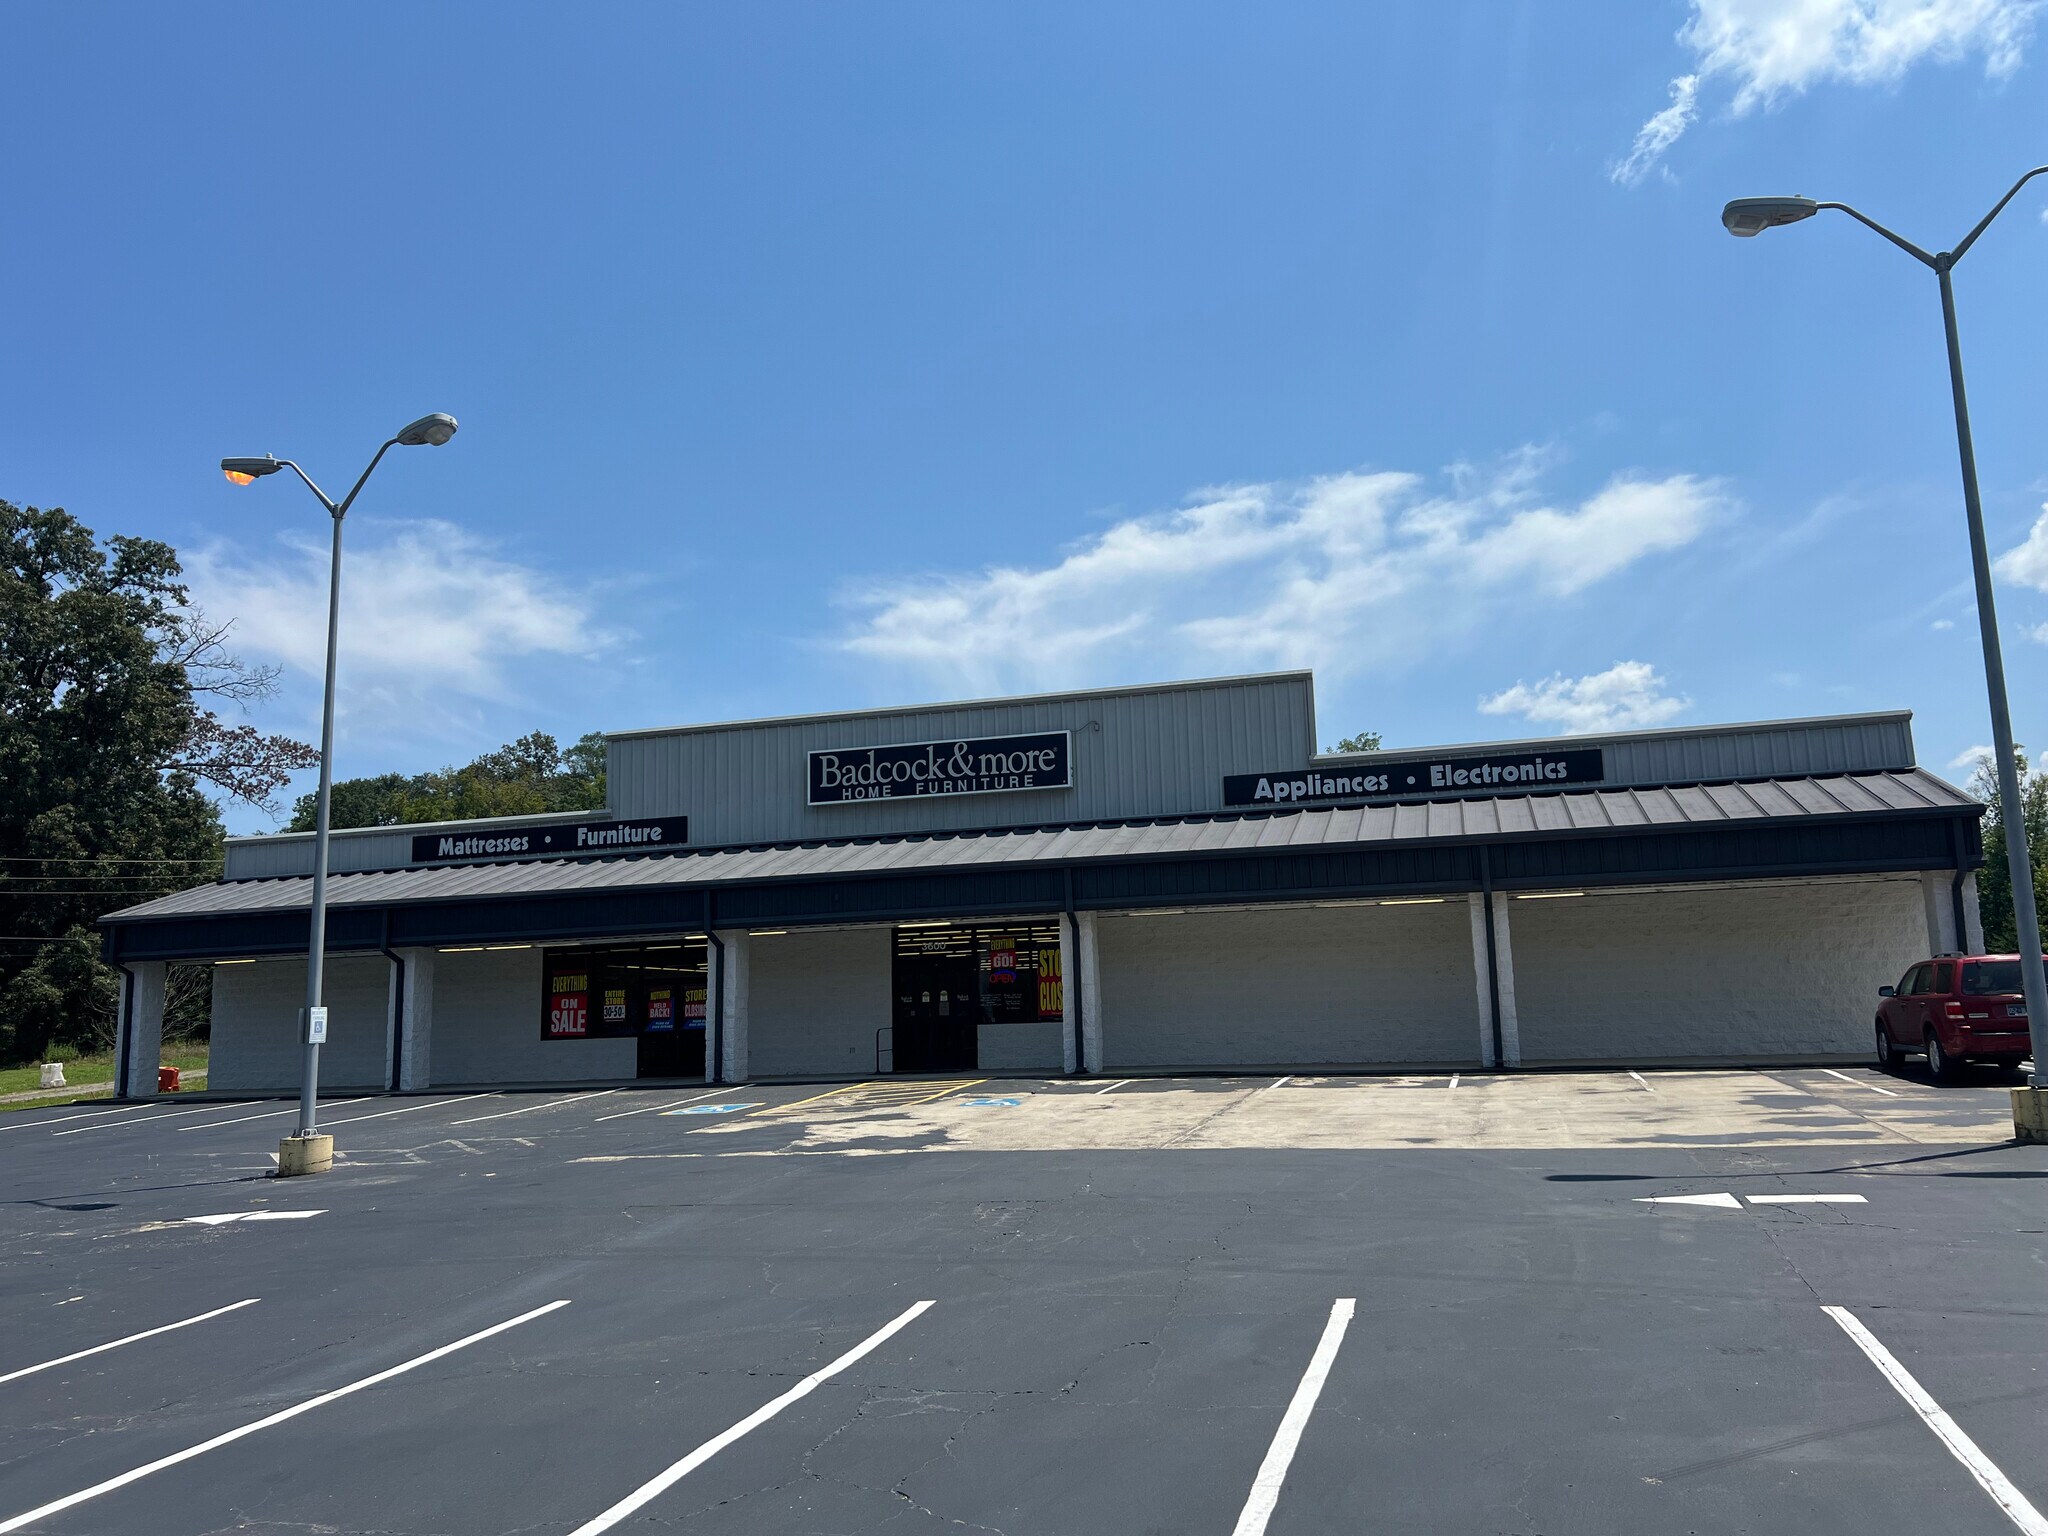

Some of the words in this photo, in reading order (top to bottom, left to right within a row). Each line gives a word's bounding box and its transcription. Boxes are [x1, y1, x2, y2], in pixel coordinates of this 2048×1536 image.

[1253, 774, 1389, 802] Appliances
[1430, 758, 1568, 788] Electronics
[842, 785, 893, 800] HOME
[916, 774, 1035, 795] FURNITURE
[438, 835, 530, 856] Mattresses
[577, 825, 662, 846] Furniture
[921, 942, 947, 951] 3600
[993, 956, 1014, 968] GO!
[552, 975, 588, 993] EVERYTHING
[990, 974, 1014, 984] OPEN
[604, 990, 625, 998] ENTIRE
[685, 989, 707, 1002] STORE
[561, 999, 578, 1009] ON
[605, 997, 625, 1005] STORE
[649, 1008, 670, 1018] BACK!
[551, 1010, 586, 1033] SALE
